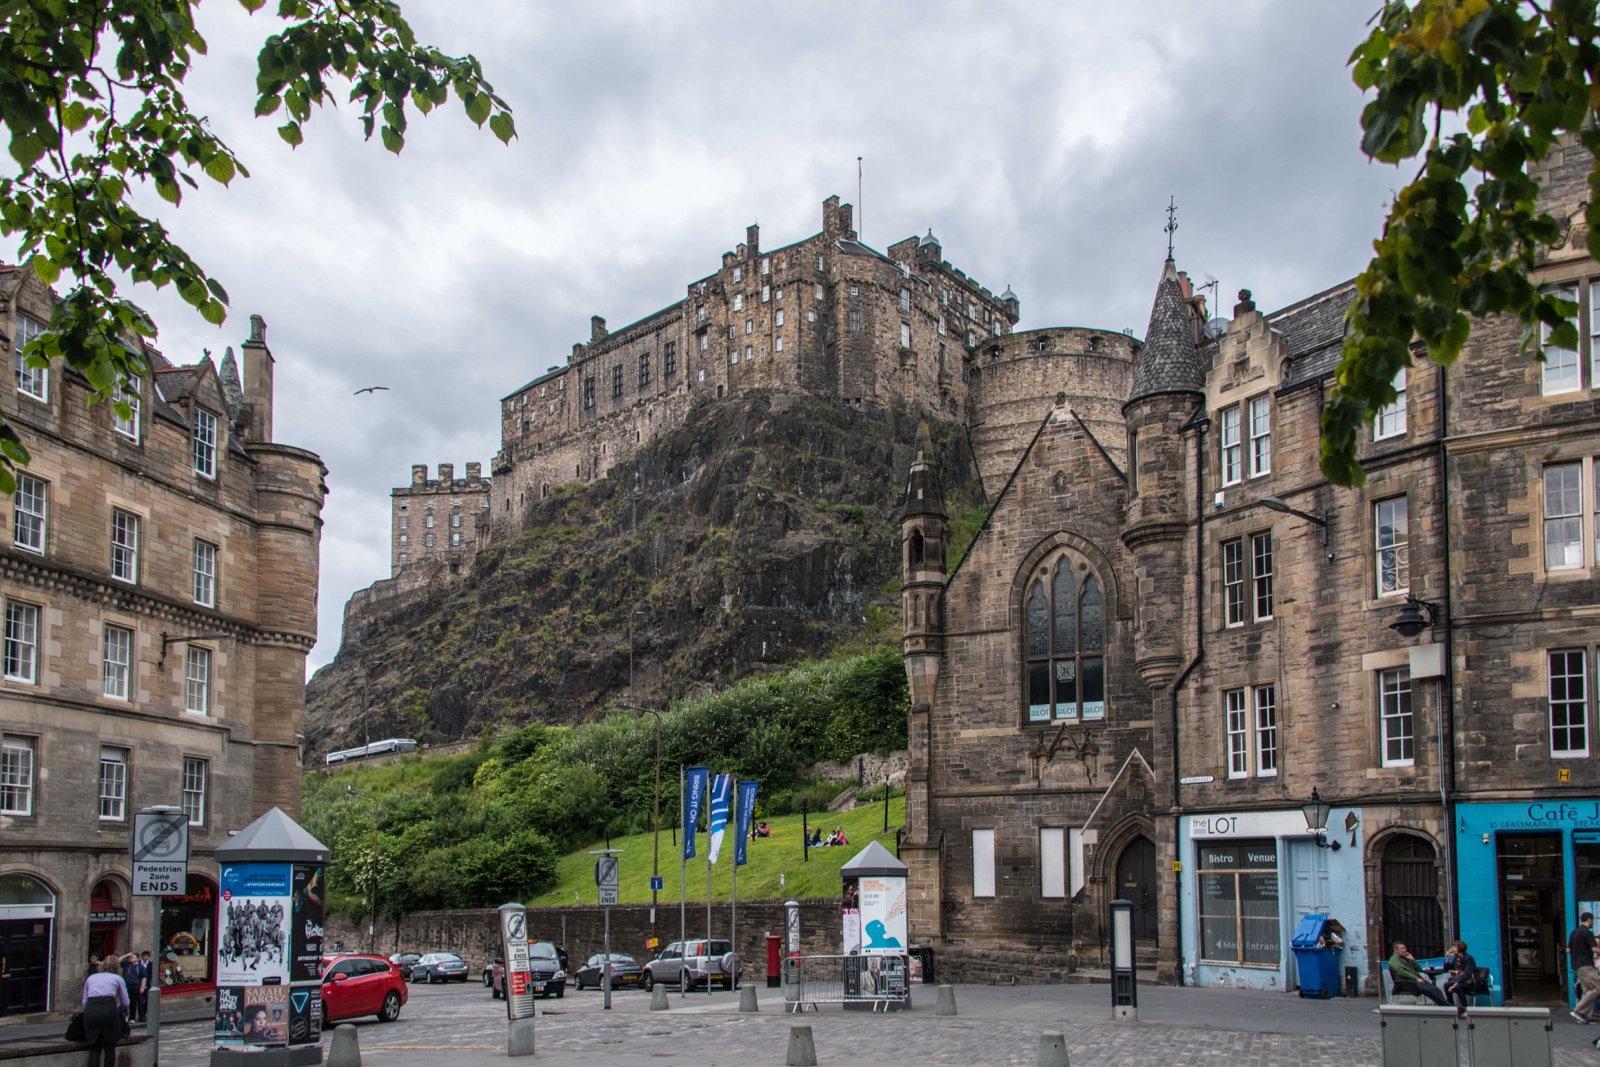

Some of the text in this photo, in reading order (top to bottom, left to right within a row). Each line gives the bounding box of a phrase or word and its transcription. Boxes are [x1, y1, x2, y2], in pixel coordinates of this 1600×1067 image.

[692, 775, 700, 800] BRING
[690, 810, 698, 823] ON
[1528, 803, 1578, 820] Café
[1193, 817, 1237, 834] the LOT
[1209, 854, 1234, 862] Bistro
[1248, 853, 1276, 862] Venue
[140, 882, 178, 892] ENDS
[1246, 942, 1280, 951] Entranc
[246, 987, 282, 996] SARAH
[247, 995, 286, 1005] JAROSZ
